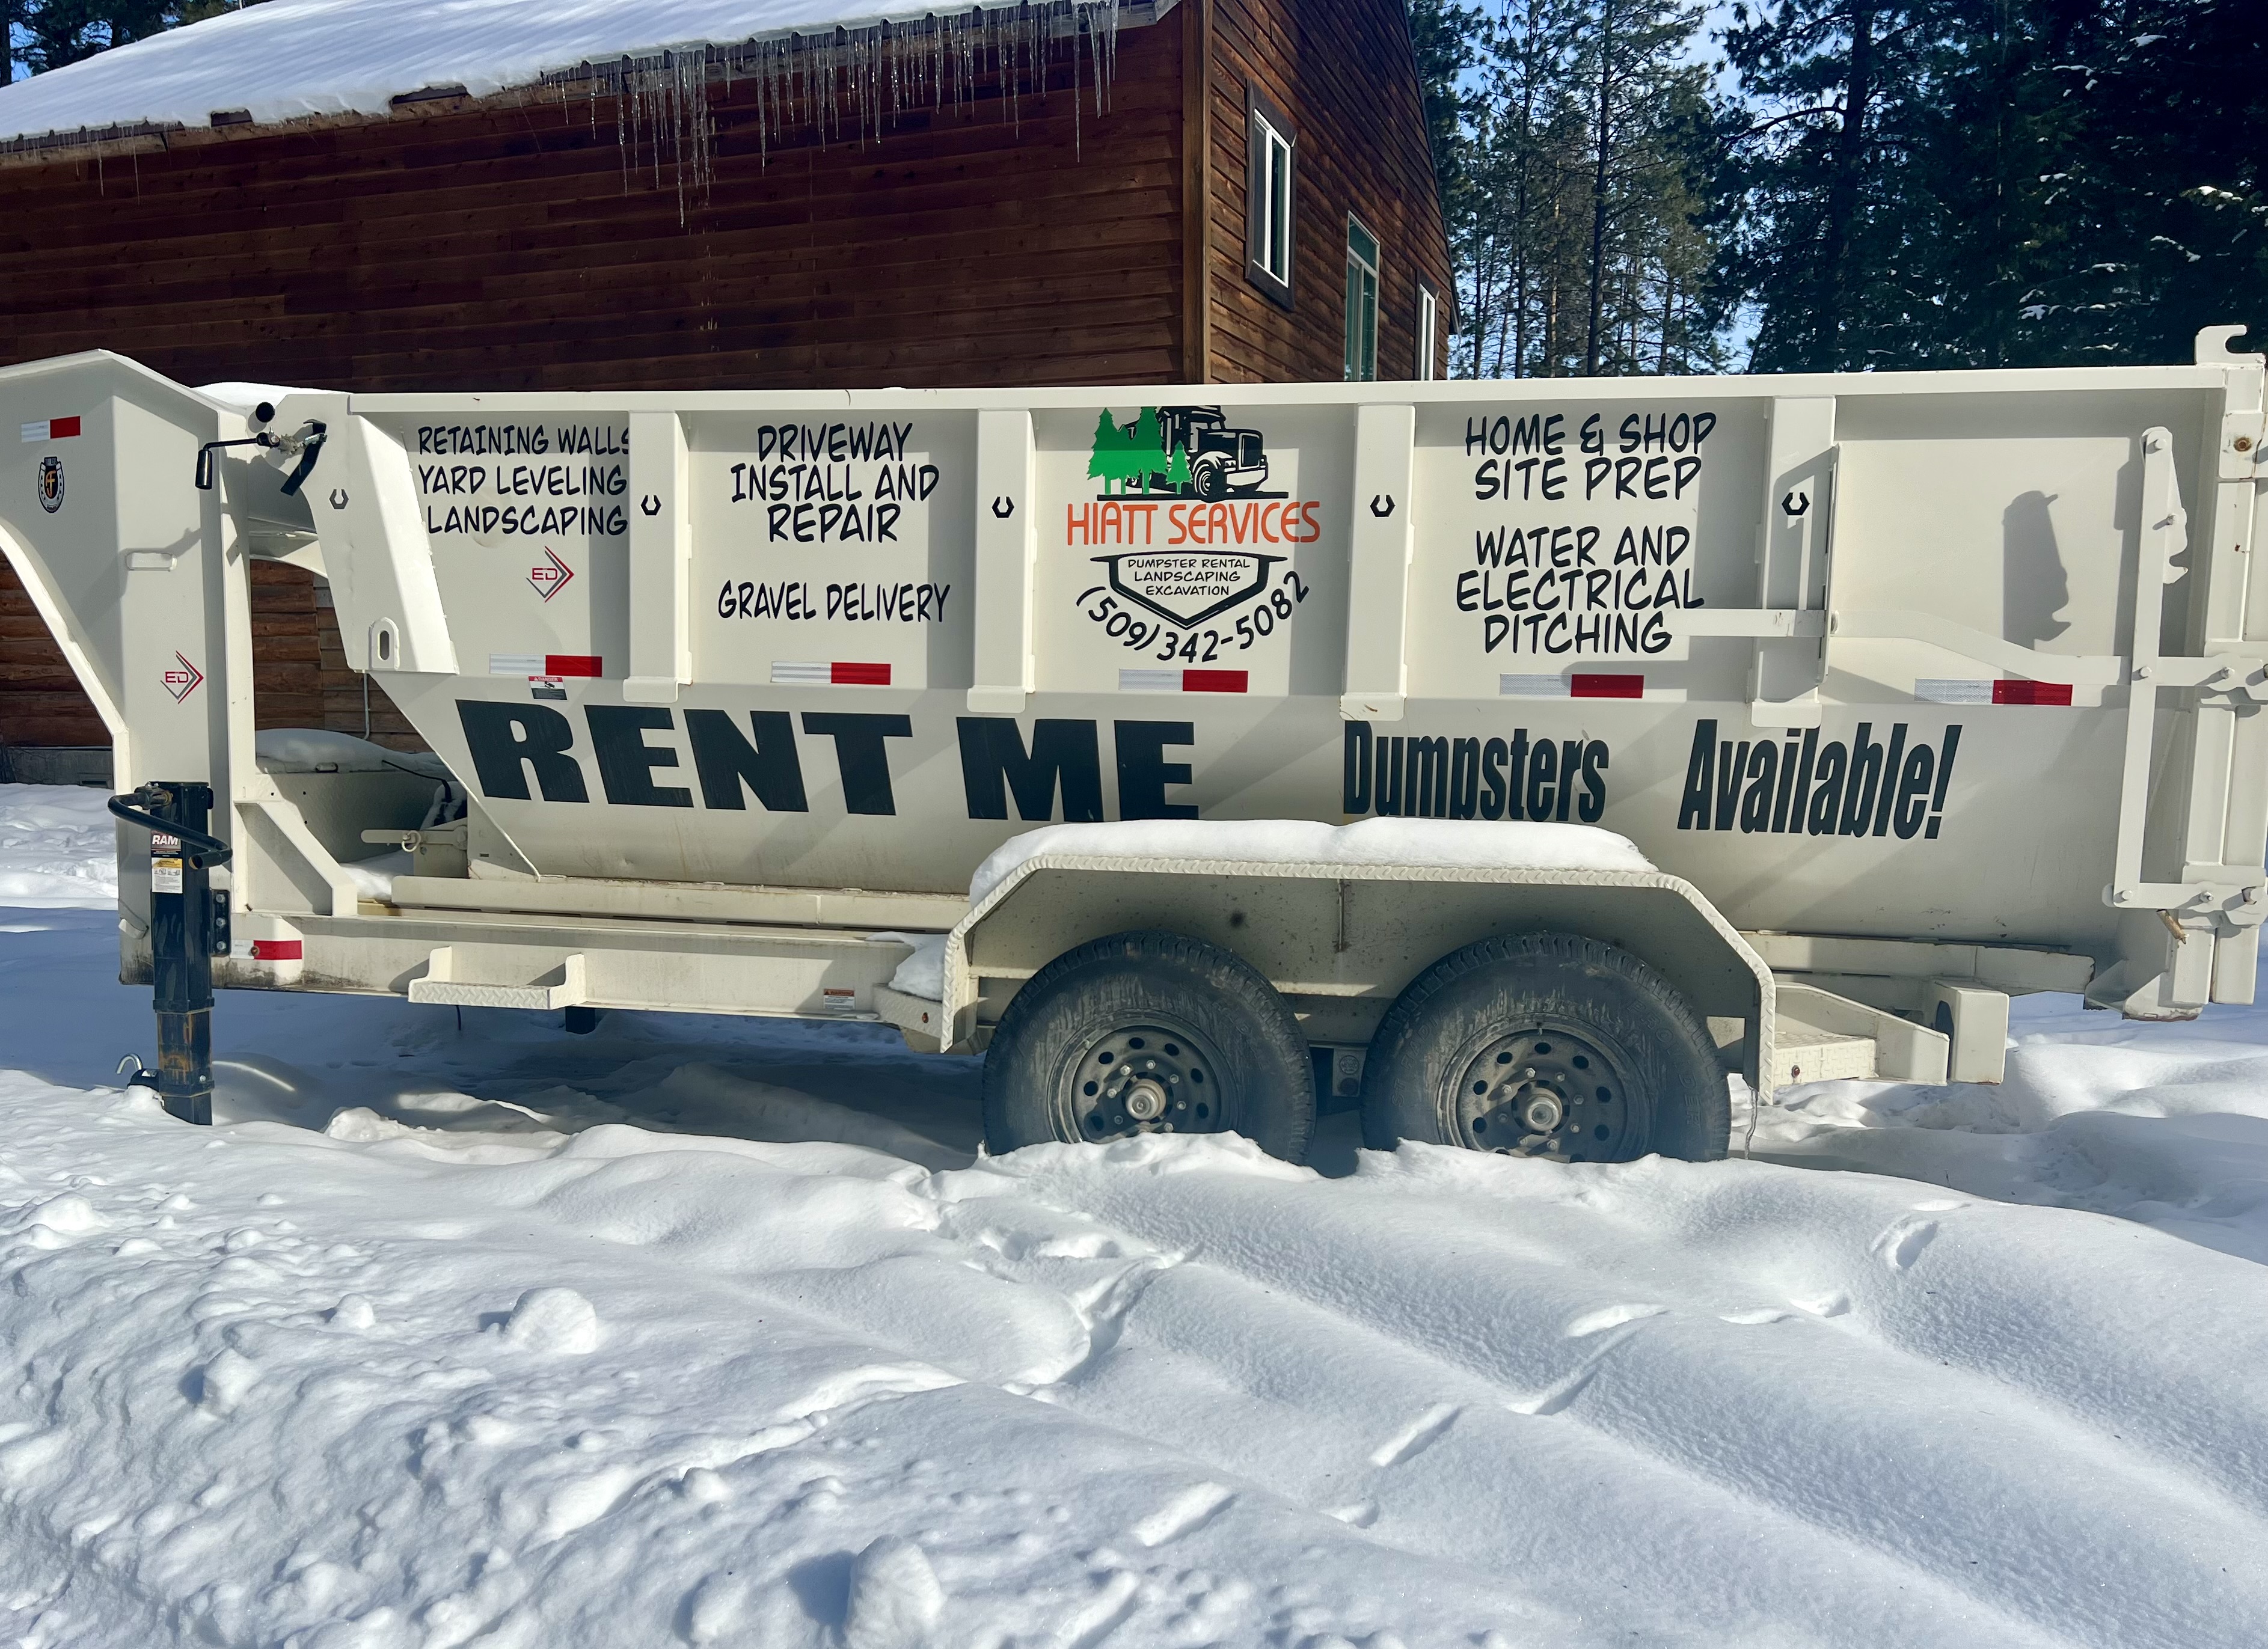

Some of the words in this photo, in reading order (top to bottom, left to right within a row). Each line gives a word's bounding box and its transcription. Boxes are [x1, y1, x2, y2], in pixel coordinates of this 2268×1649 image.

[418, 424, 549, 456] RETAINING
[758, 421, 913, 462] DRIVEWAY
[1466, 414, 1565, 456] HOME
[1580, 413, 1604, 456] &
[1620, 412, 1716, 454] SHOP
[418, 465, 485, 494] YARD
[497, 465, 627, 495] LEVELING
[731, 463, 862, 503] INSTALL
[875, 464, 939, 501] AND
[1476, 457, 1567, 500] SITE
[1586, 456, 1701, 500] PREP
[428, 505, 628, 536] LANDSCAPING
[767, 503, 900, 543] REPAIR
[1067, 501, 1158, 545] HIATT
[1168, 501, 1320, 545] SERVICES
[1128, 558, 1197, 568] DUMPSTER
[1202, 559, 1251, 568] RENTAL
[1477, 525, 1599, 568] WATER
[1614, 525, 1689, 566] AND
[532, 568, 558, 580] ED
[1135, 571, 1240, 581] LANDSCAPING
[1146, 586, 1228, 595] EXCAVATION
[1457, 567, 1705, 611] ELECTRICAL
[719, 580, 816, 620] GRAVEL
[827, 583, 950, 622] DELIVERY
[1485, 610, 1673, 654] DITCHING
[165, 671, 189, 684] ED
[456, 699, 913, 816] RENT
[956, 717, 1200, 822] ME
[1343, 720, 1609, 822] Dumpsters
[1677, 720, 1963, 839] Available!
[152, 834, 179, 845] RAM
